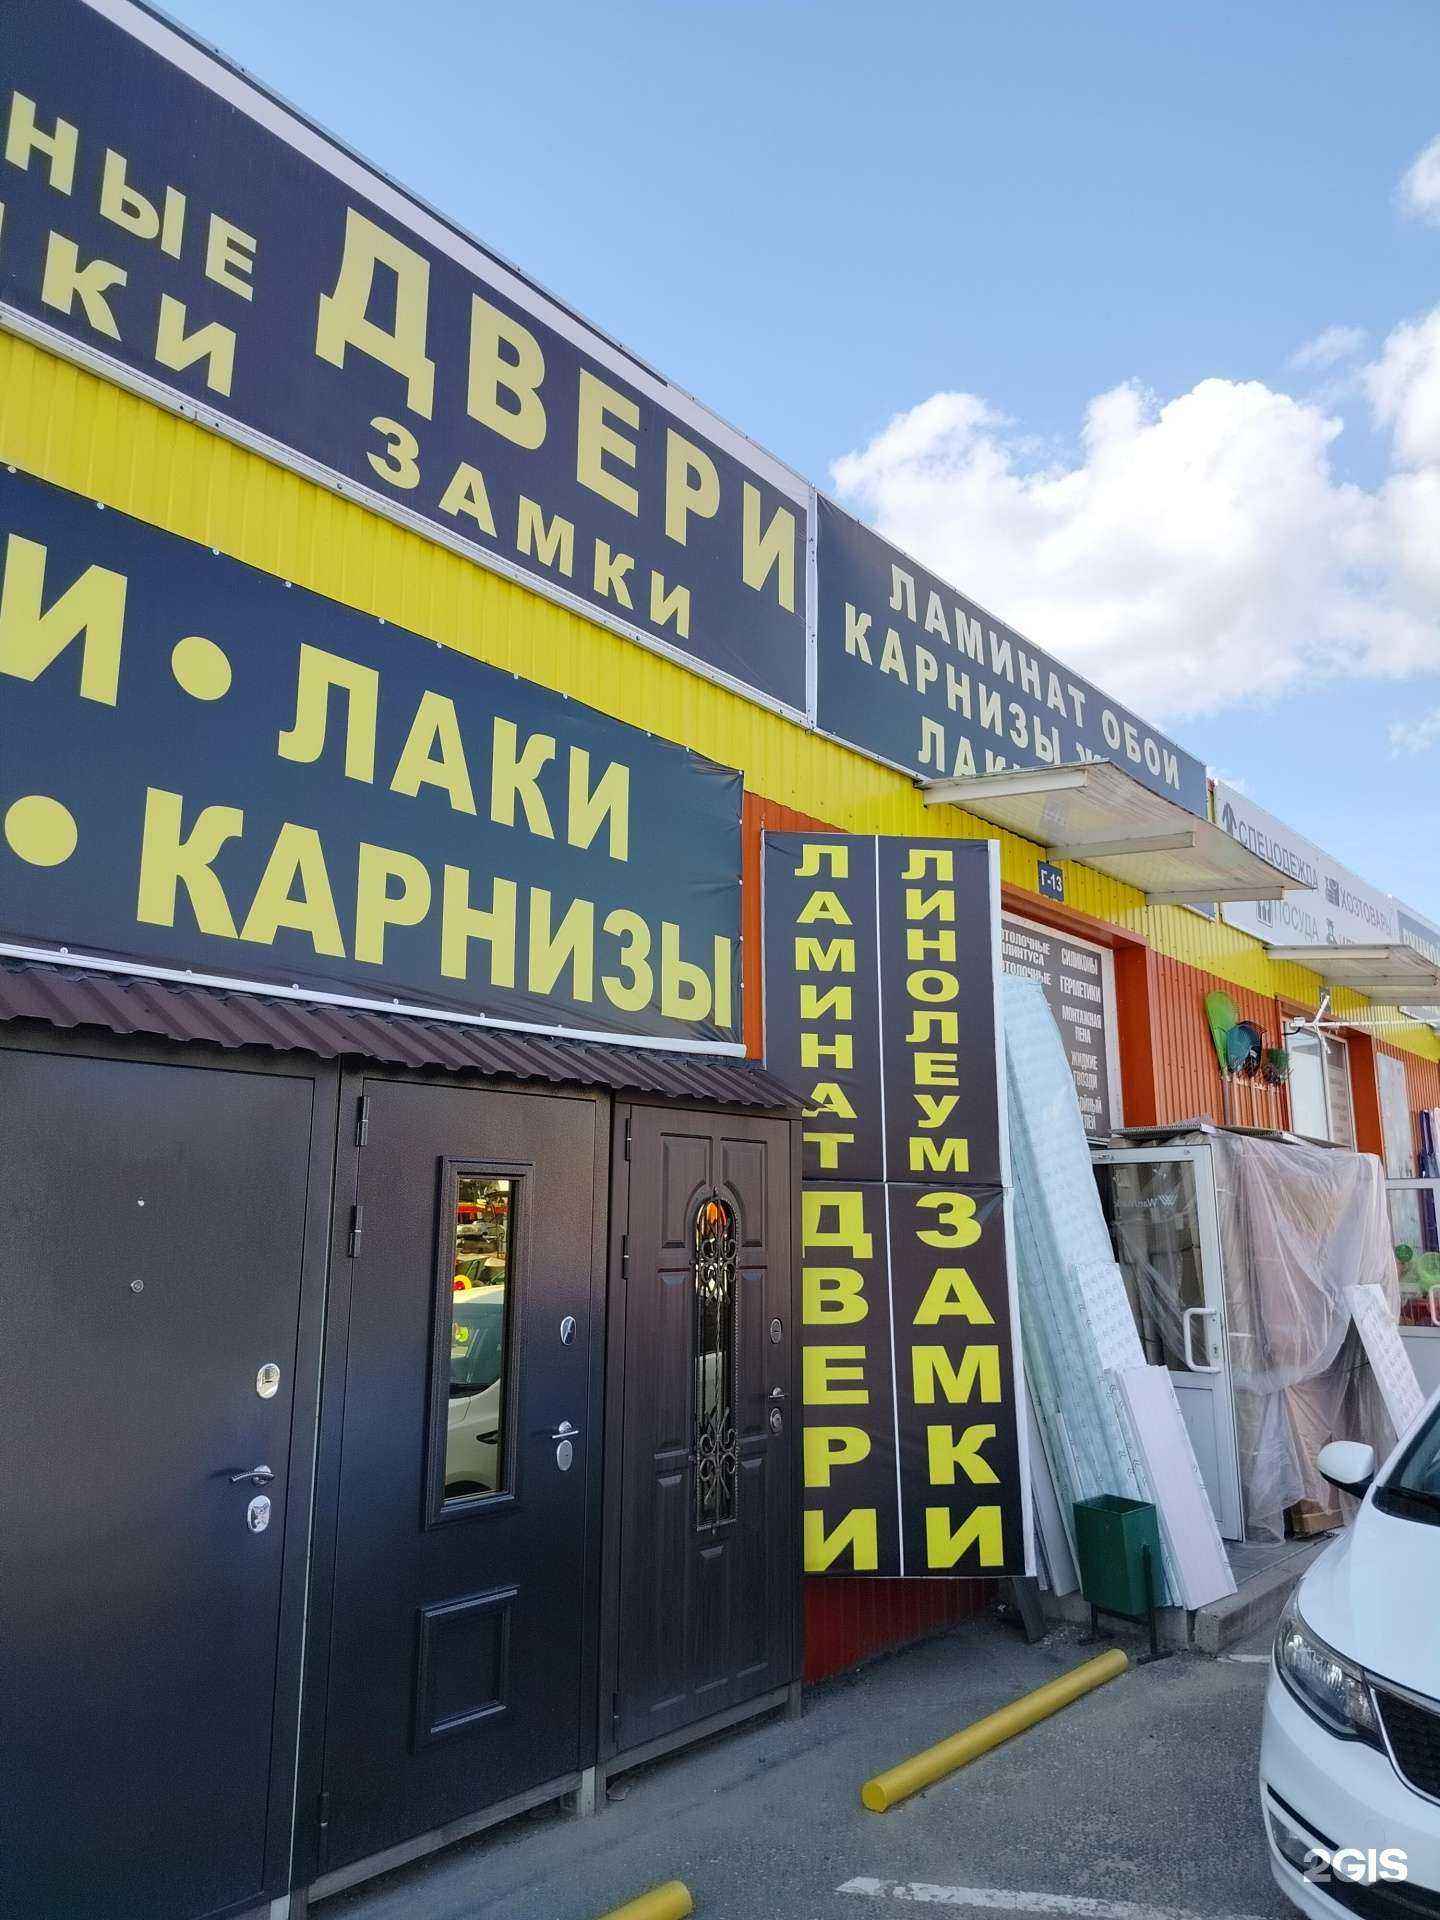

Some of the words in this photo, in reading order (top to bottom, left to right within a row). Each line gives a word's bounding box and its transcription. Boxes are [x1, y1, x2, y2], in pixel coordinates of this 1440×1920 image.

[0, 202, 237, 398] КИ
[366, 417, 692, 640] ЗАМКИ
[5, 90, 257, 302] НЫЕ
[314, 206, 797, 613] ДВЕРИ
[278, 642, 630, 862] ЛАКИ
[845, 602, 1060, 765] КАРНИЗЫ
[889, 563, 1086, 728] ЛАМИНАТ
[1101, 708, 1180, 791] ОБОИ
[918, 716, 1021, 777] ЛАК
[137, 787, 732, 1028] КАРНИЗЫ
[1041, 869, 1063, 892] Г-13
[1239, 820, 1318, 891] СПЕЦОДЕЖДА
[1274, 899, 1319, 943] ПОСУДА
[794, 844, 858, 1169] ЛАМИНАТ
[901, 848, 970, 1172] ЛИНОЛЕУМ
[1060, 975, 1101, 1003] ГЕРМЕТИКИ
[1061, 947, 1098, 975] СИЛИКОНЫ
[1062, 1004, 1102, 1029] МОНТАЖНАЯ
[1075, 1026, 1091, 1044] ПЕНА
[802, 1190, 878, 1573] ДВЕРИ
[912, 1192, 1004, 1569] ЗАМКИ
